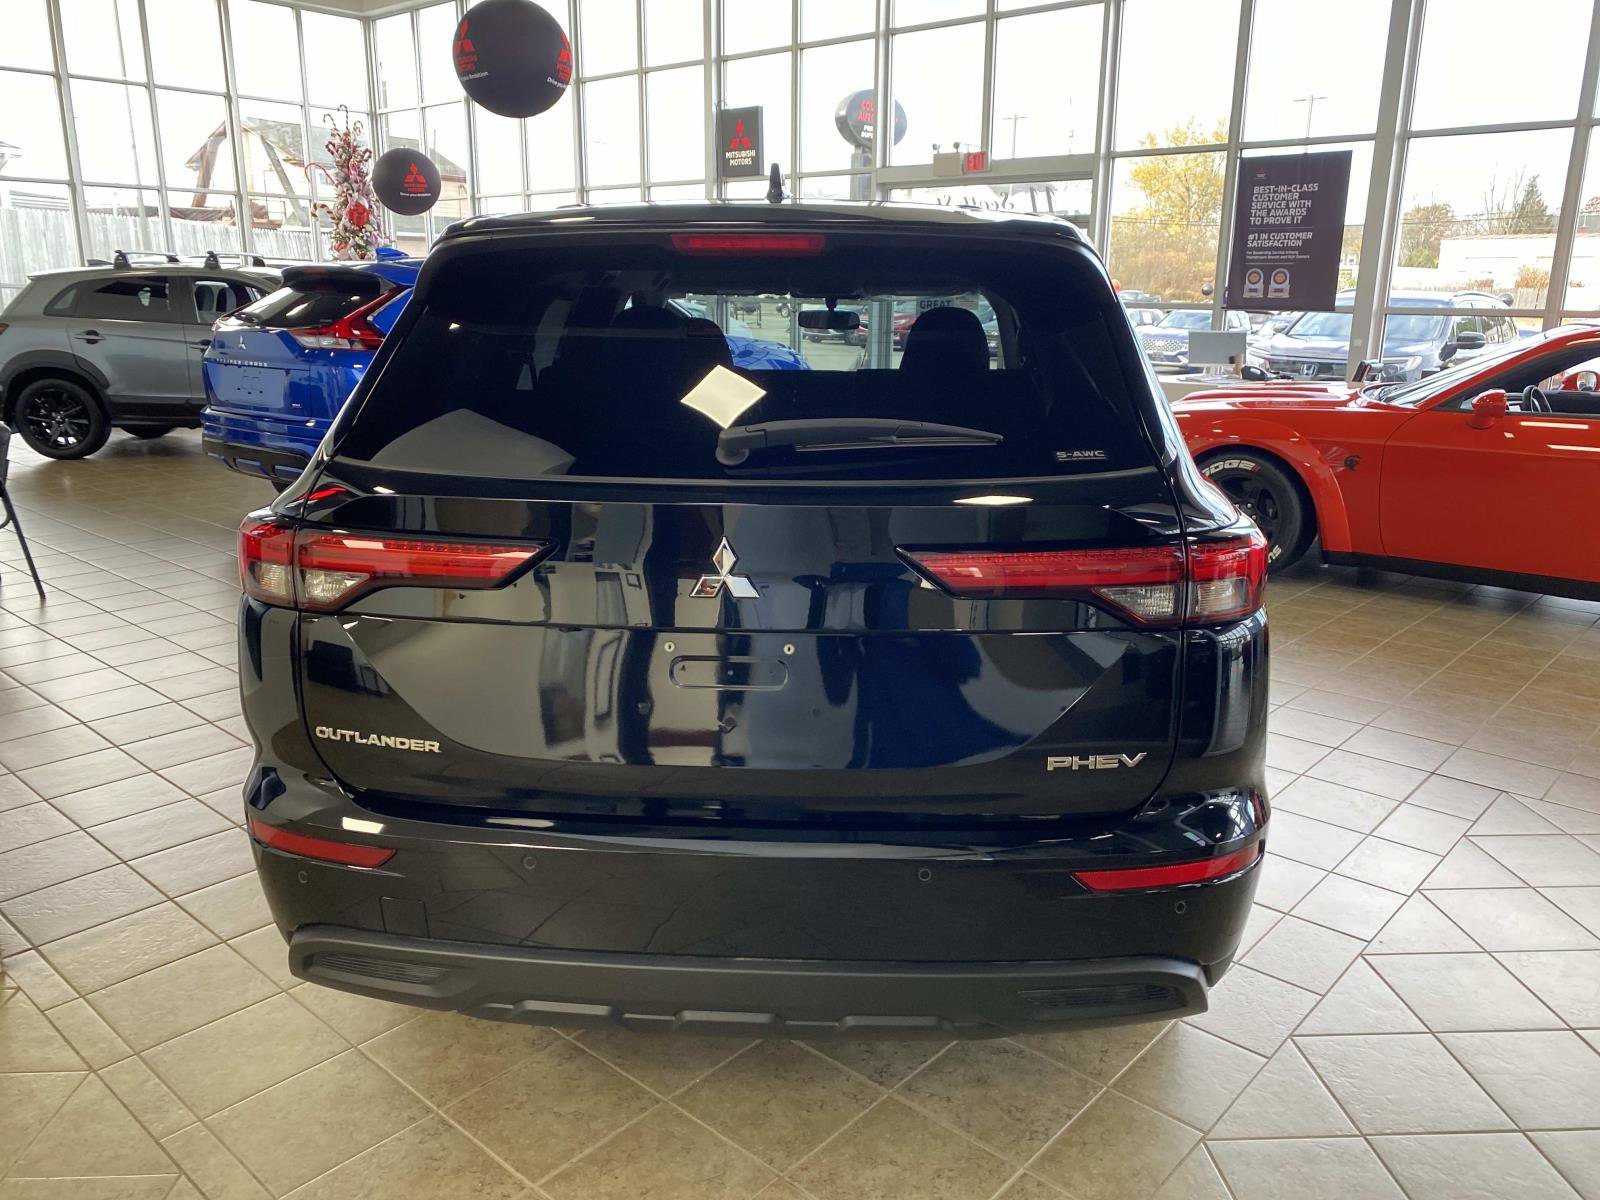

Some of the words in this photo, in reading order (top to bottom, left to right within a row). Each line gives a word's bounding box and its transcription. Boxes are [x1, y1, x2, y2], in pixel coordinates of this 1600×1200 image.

[725, 149, 756, 159] MITSUBISHI
[729, 157, 753, 166] MOTORS
[966, 151, 985, 172] EXIT
[1253, 183, 1319, 194] BEST-IN-CLASS
[1252, 192, 1300, 202] CUSTOMER
[1251, 200, 1287, 210] SERVICE
[1288, 199, 1312, 208] WITH
[1250, 209, 1268, 217] THE
[1269, 207, 1307, 217] AWARDS
[1249, 217, 1262, 225] TO
[1263, 216, 1292, 225] PROVE
[1293, 215, 1303, 224] IT
[1259, 232, 1269, 240] IN
[1269, 231, 1313, 240] CUSTOMER
[1246, 239, 1303, 248] SATISFACTION
[919, 299, 952, 310] GREAT
[1056, 450, 1105, 458] S-AWC
[315, 725, 442, 753] OUTLANDER
[1046, 751, 1148, 771] PHEV
